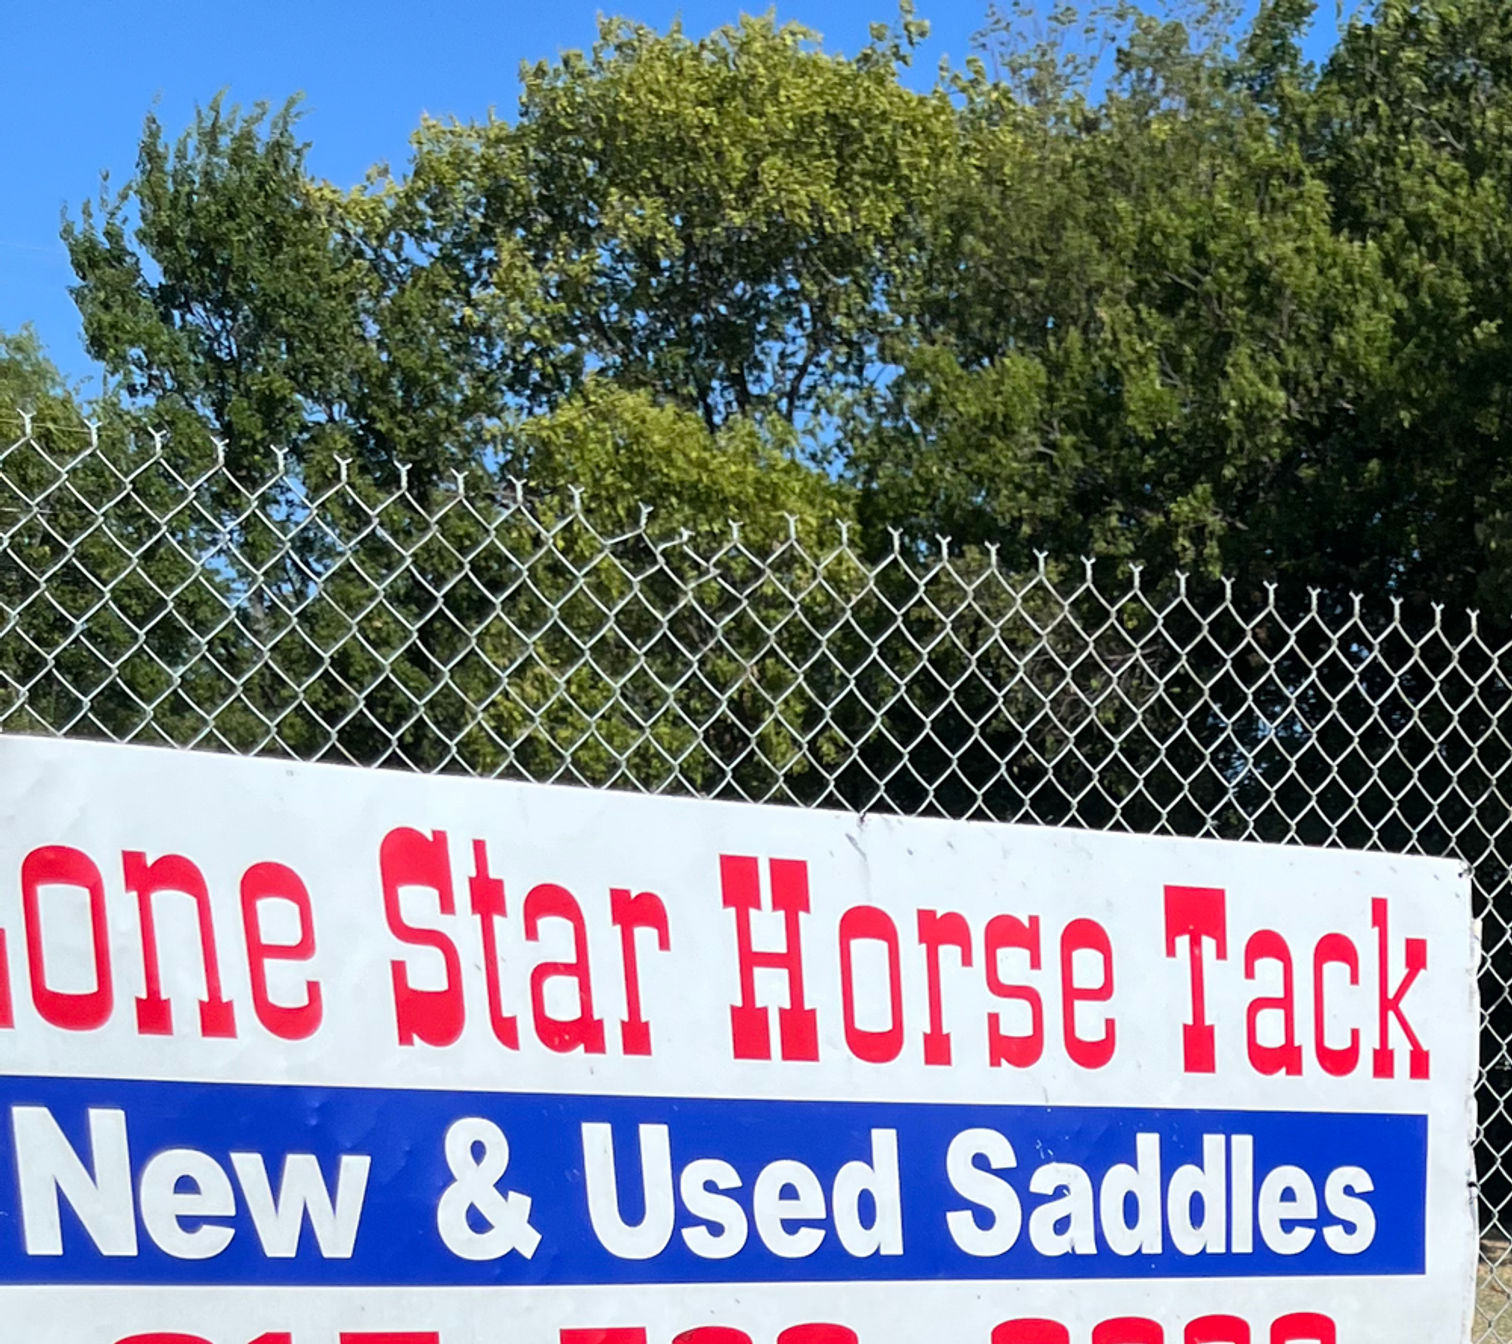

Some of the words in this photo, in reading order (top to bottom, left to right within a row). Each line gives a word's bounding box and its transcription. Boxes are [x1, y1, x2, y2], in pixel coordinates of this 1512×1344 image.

[0, 844, 323, 1041] one
[379, 826, 671, 1056] Star
[719, 854, 1117, 1070] Horse
[1163, 884, 1430, 1081] Tack
[11, 1105, 372, 1260] New
[436, 1116, 542, 1261] &
[580, 1121, 904, 1260] Used
[945, 1127, 1376, 1257] Saddles
